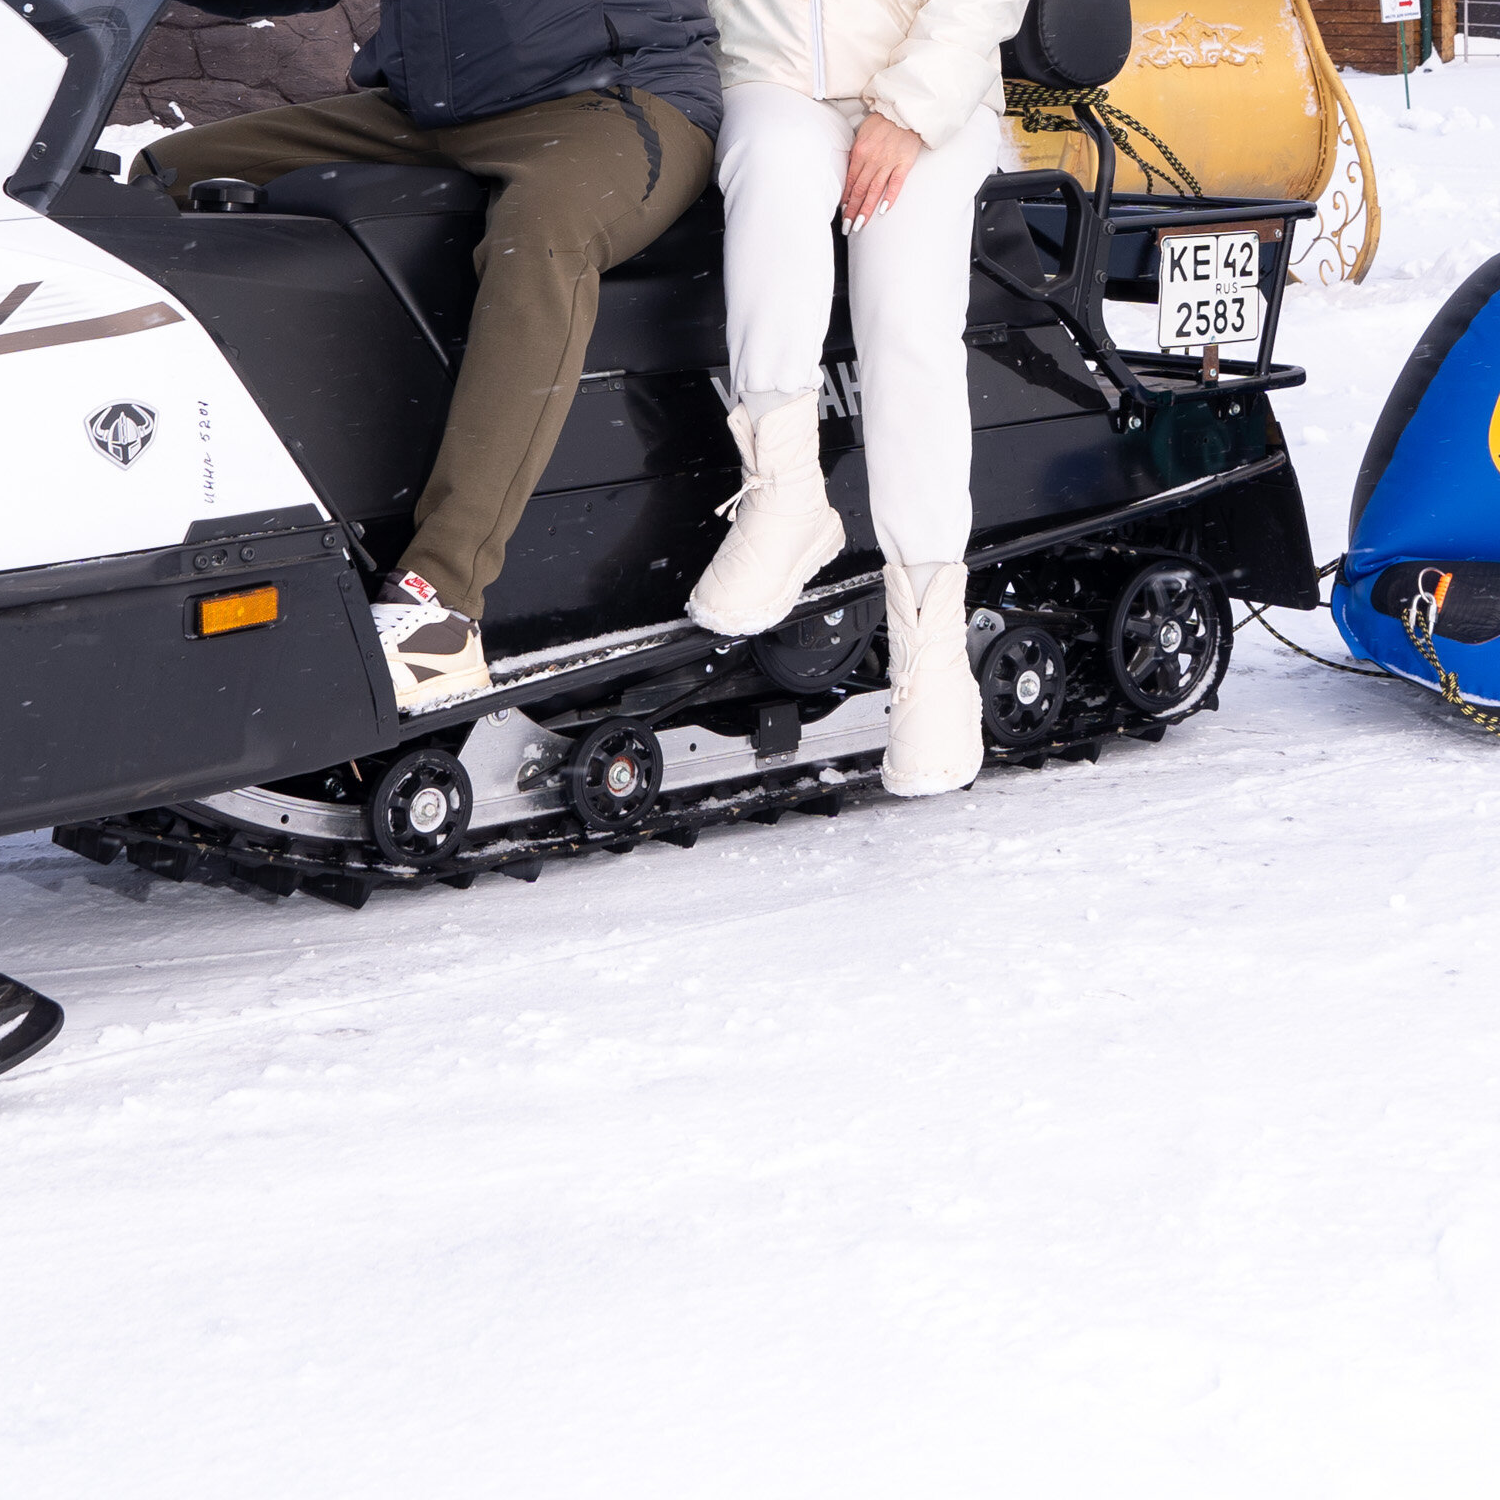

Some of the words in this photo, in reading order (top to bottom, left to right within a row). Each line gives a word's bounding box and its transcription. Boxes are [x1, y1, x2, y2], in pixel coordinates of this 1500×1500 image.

[1223, 242, 1253, 278] 42
[1215, 282, 1238, 295] RUS
[1176, 297, 1245, 338] 2583
